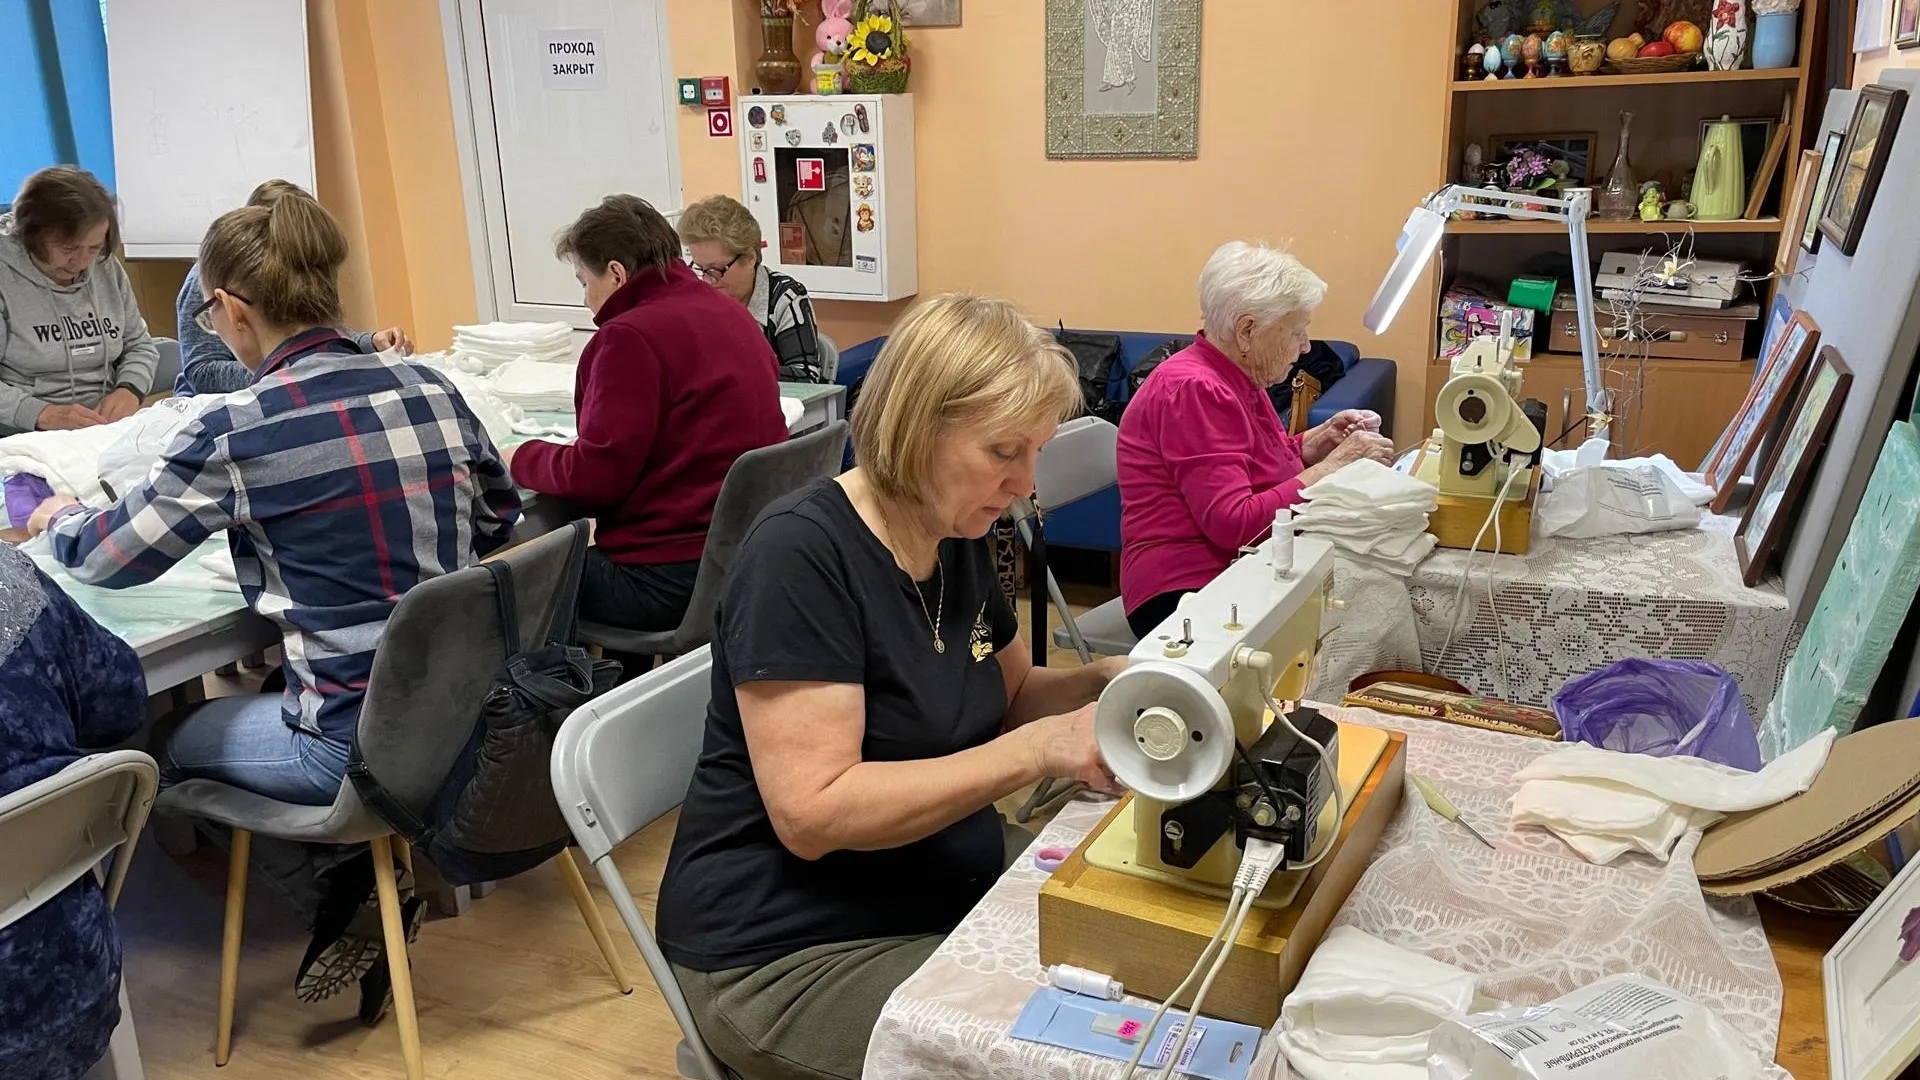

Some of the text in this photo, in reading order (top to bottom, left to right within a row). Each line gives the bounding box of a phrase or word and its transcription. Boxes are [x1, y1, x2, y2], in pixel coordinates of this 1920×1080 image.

[549, 42, 596, 56] ПРОХОД
[552, 63, 595, 75] ЗАКРЫТ
[32, 312, 120, 343] welbeing.
[1577, 1036, 1587, 1045] 10
[1596, 1036, 1642, 1059] медицинского
[1544, 1041, 1599, 1069] НЕСТЕРИЛЬНЫЕ
[1565, 1054, 1597, 1071] изделия:
